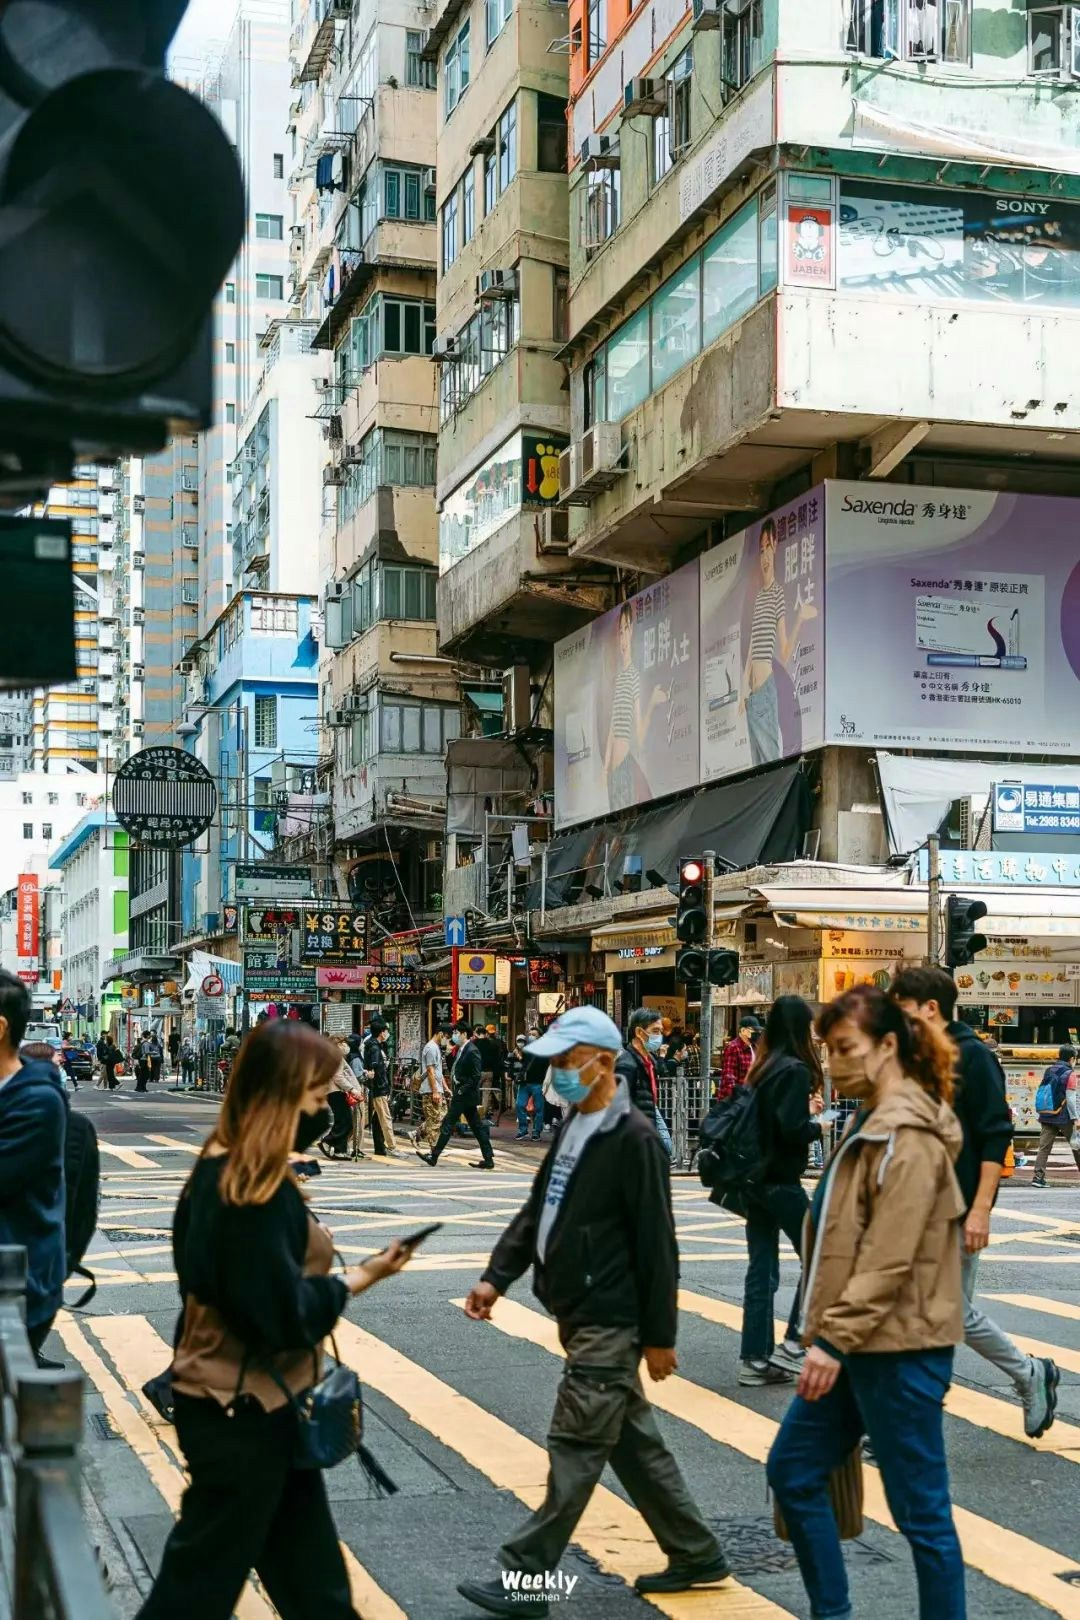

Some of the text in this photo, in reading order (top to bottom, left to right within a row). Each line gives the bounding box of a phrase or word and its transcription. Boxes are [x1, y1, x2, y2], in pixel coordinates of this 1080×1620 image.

[996, 200, 1050, 214] SONY
[793, 264, 827, 275] JABEN
[841, 494, 916, 516] Saxenda
[777, 497, 819, 543] 適合關注
[785, 533, 816, 583] 肥胖
[910, 578, 950, 590] Saxenda
[793, 577, 816, 611] 人士
[1025, 790, 1079, 809] 易通集團
[482, 976, 489, 985] 7
[482, 989, 493, 999] 12
